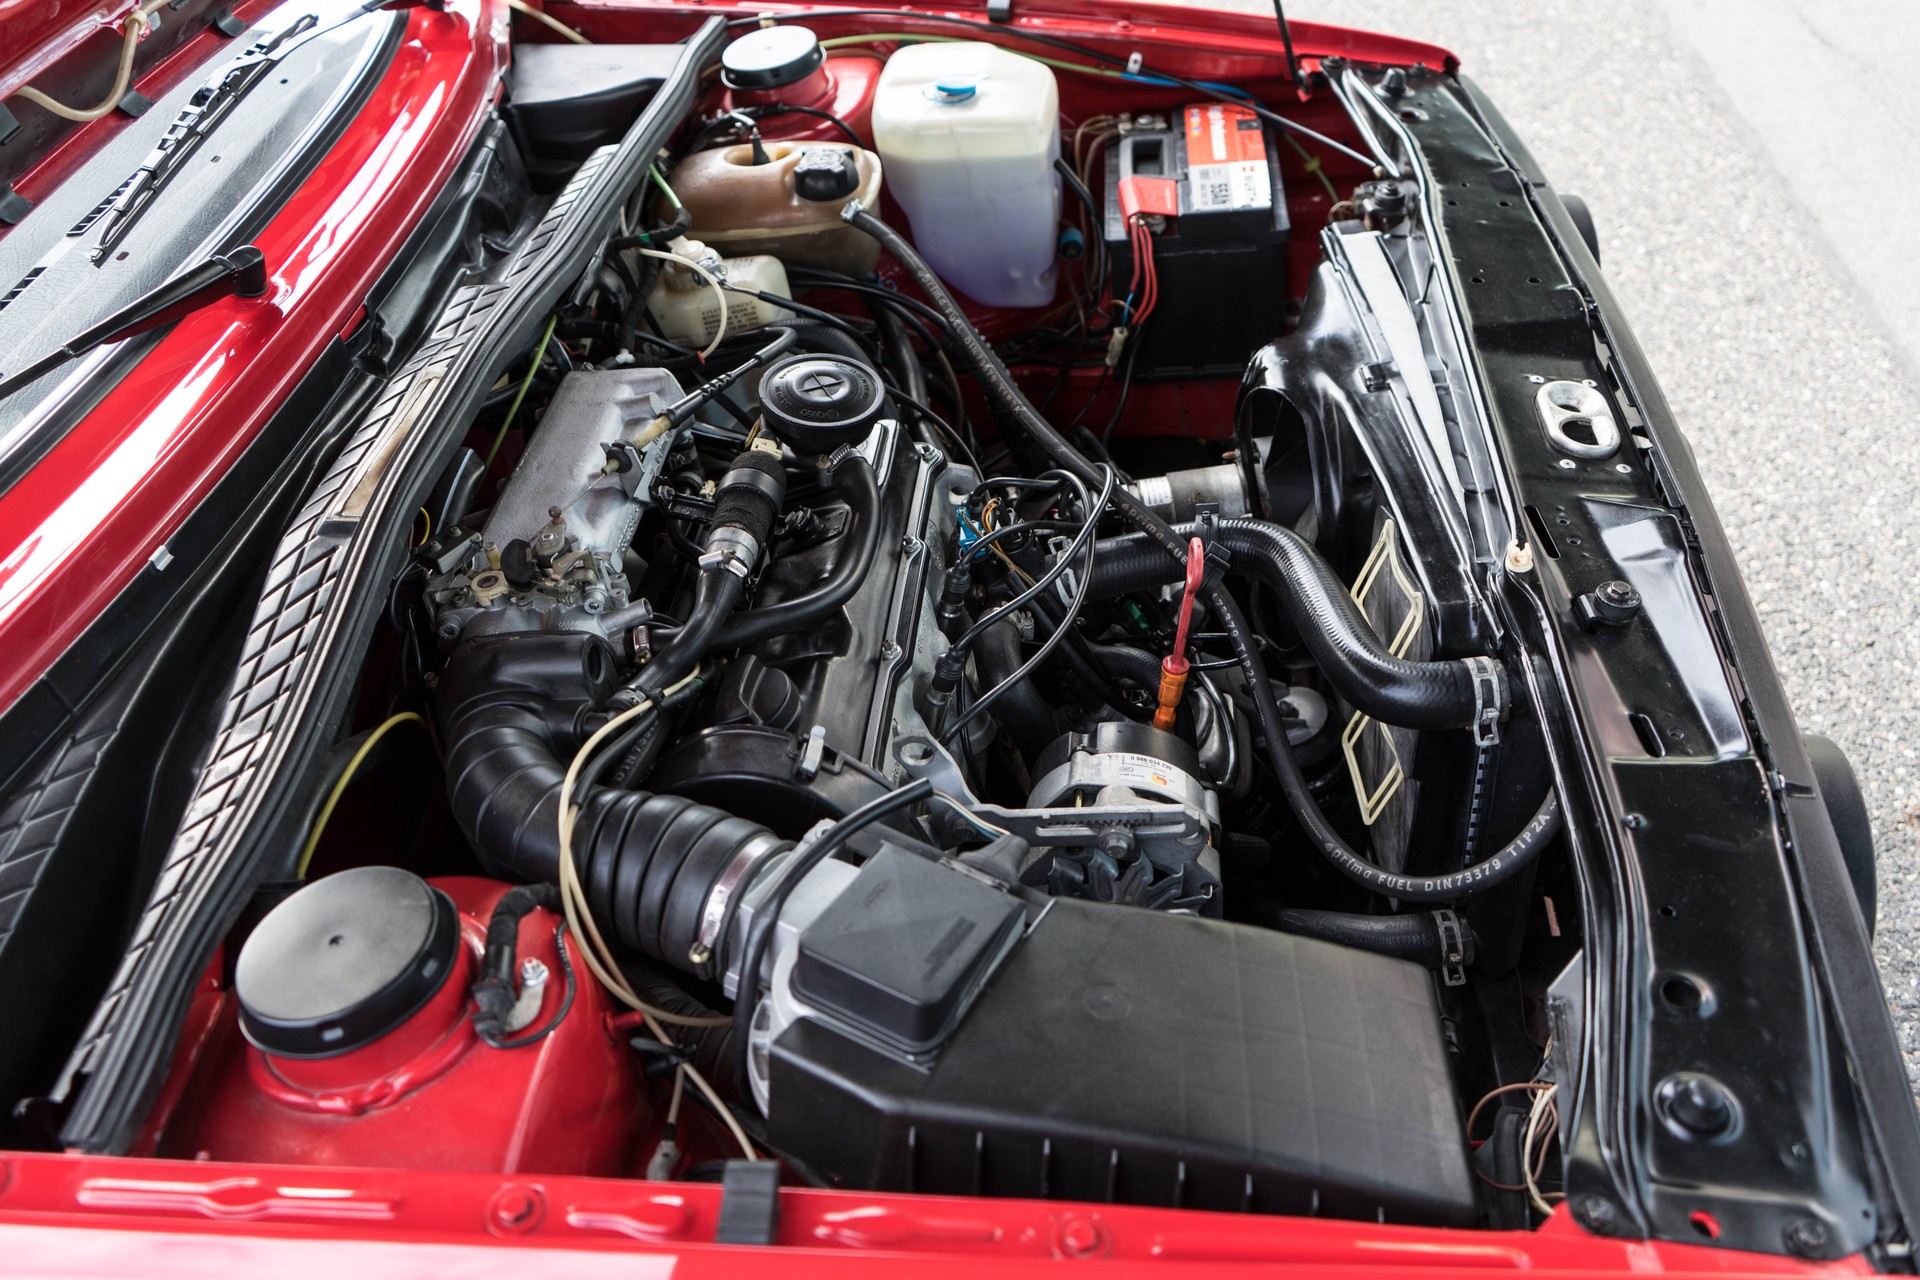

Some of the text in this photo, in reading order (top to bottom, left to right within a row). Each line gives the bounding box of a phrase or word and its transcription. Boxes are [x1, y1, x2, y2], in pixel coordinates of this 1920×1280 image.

[1210, 183, 1229, 205] 55Ah
[944, 307, 963, 334] FUEL
[1128, 508, 1164, 540] prima
[1167, 542, 1188, 565] FUE
[1330, 849, 1371, 880] prima
[1378, 874, 1414, 892] FUEL
